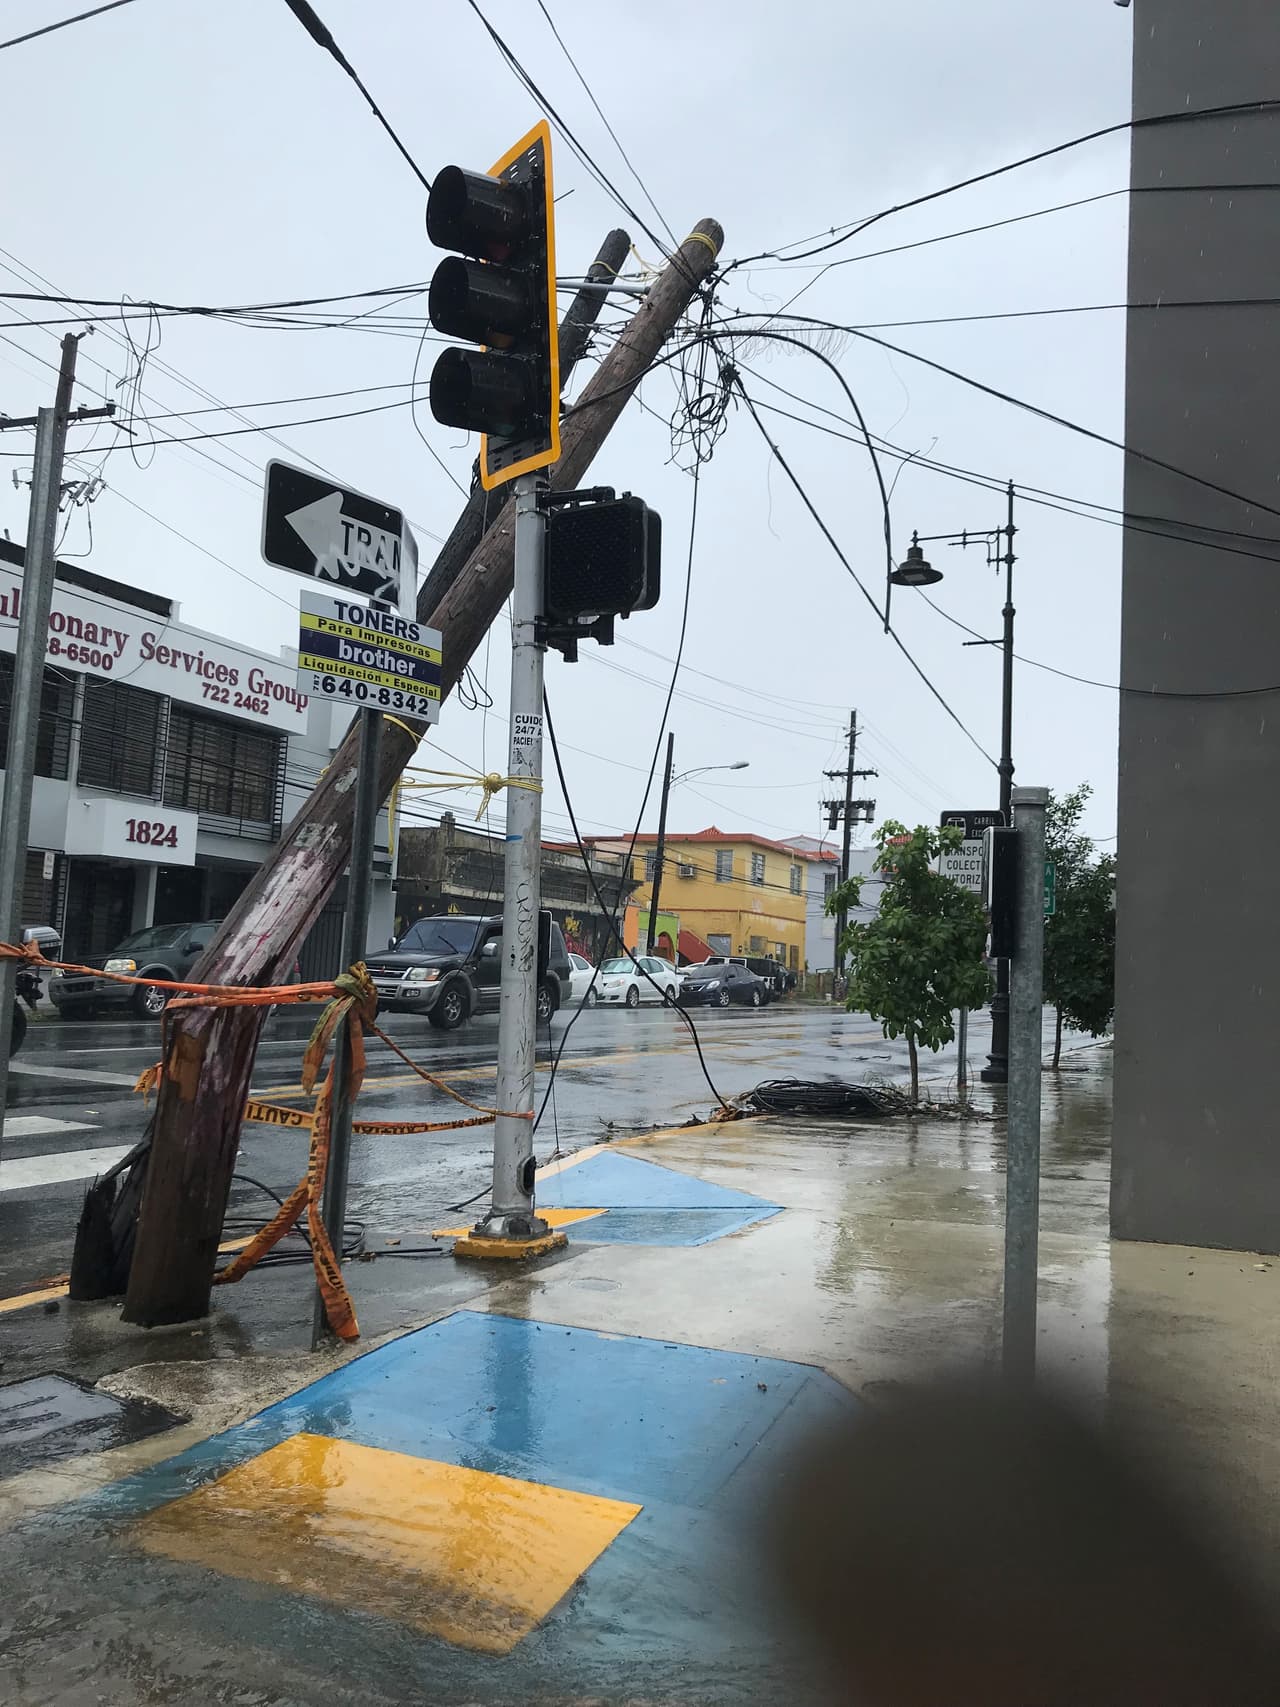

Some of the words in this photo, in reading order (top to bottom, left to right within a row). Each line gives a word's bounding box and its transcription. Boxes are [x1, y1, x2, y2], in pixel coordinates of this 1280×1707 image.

[317, 618, 353, 636] Para
[358, 628, 432, 659] Impresoras
[334, 600, 421, 642] TONERS
[46, 637, 114, 672] 8-6500
[139, 631, 240, 687] Services
[248, 667, 309, 714] Group
[338, 639, 416, 677] brother
[303, 656, 383, 683] Liquidación
[393, 678, 438, 698] Especial
[321, 675, 430, 716] 640-8342
[201, 682, 230, 705] 722
[233, 691, 269, 716] 2462
[515, 725, 535, 735] 24/7
[125, 818, 178, 848] 1824
[946, 860, 981, 871] COLECT
